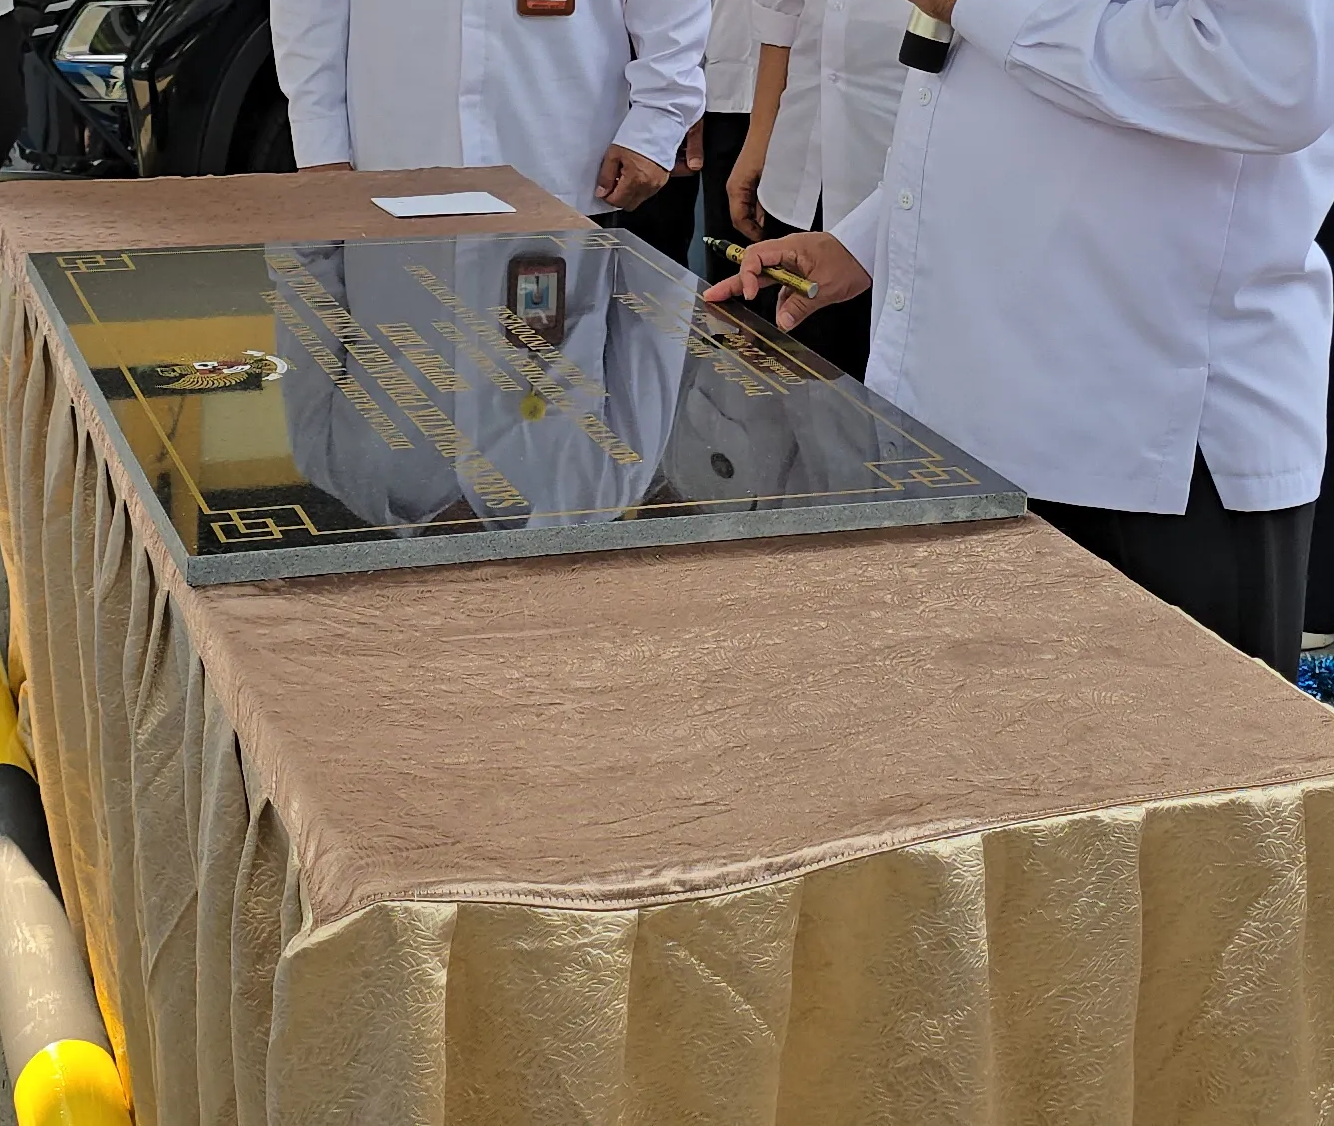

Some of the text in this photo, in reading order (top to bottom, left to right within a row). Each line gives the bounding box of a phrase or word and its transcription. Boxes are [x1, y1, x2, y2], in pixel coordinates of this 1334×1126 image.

[310, 307, 372, 341] LISTRIK
[483, 305, 555, 350] INDONESIA
[305, 345, 347, 372] TUHAN
[342, 342, 433, 406] PEMBANGKIT
[328, 373, 379, 408] RAHMAT
[400, 406, 481, 457] PRAKTIK
